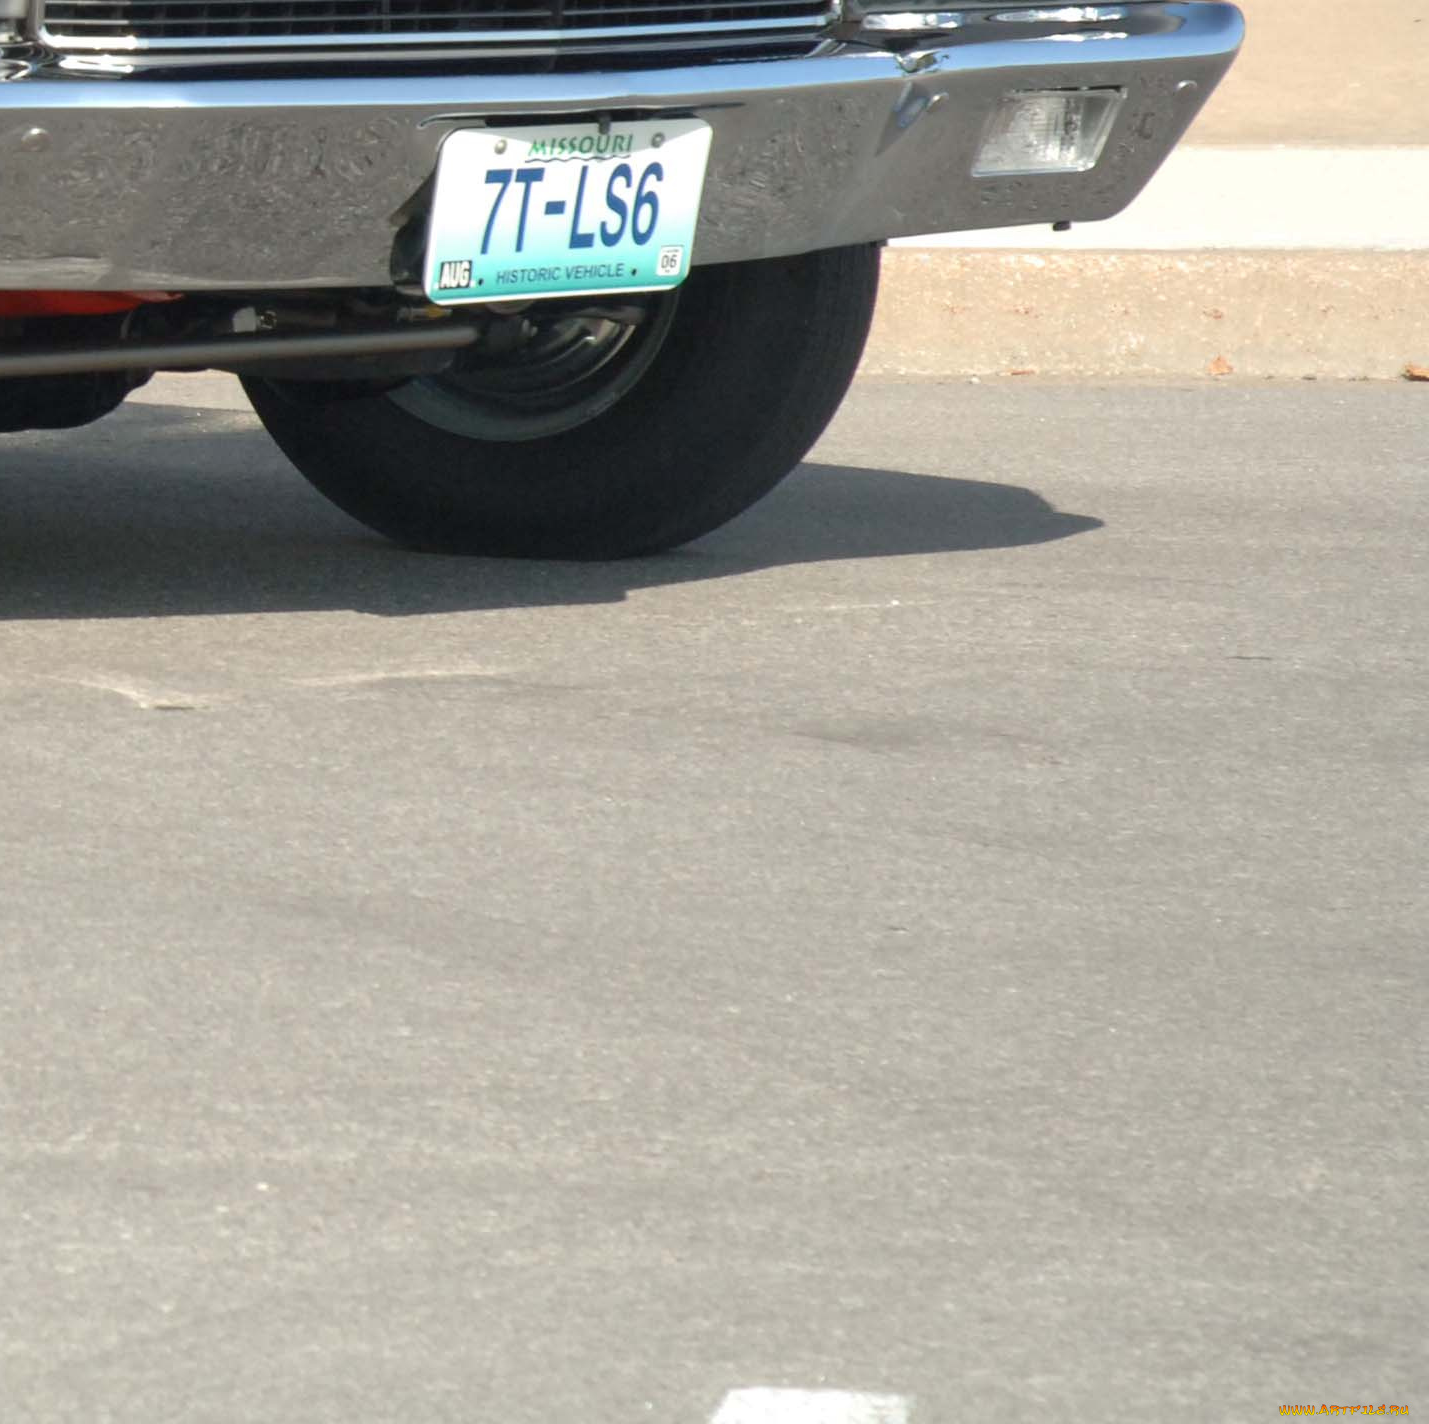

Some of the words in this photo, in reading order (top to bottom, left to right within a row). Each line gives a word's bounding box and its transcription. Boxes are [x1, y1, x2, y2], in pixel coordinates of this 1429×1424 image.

[528, 134, 634, 157] MISSOURI
[480, 161, 664, 255] 7T-LS6
[440, 261, 471, 289] AUG
[495, 266, 561, 285] HISTORIC
[565, 263, 625, 281] VEHICLE
